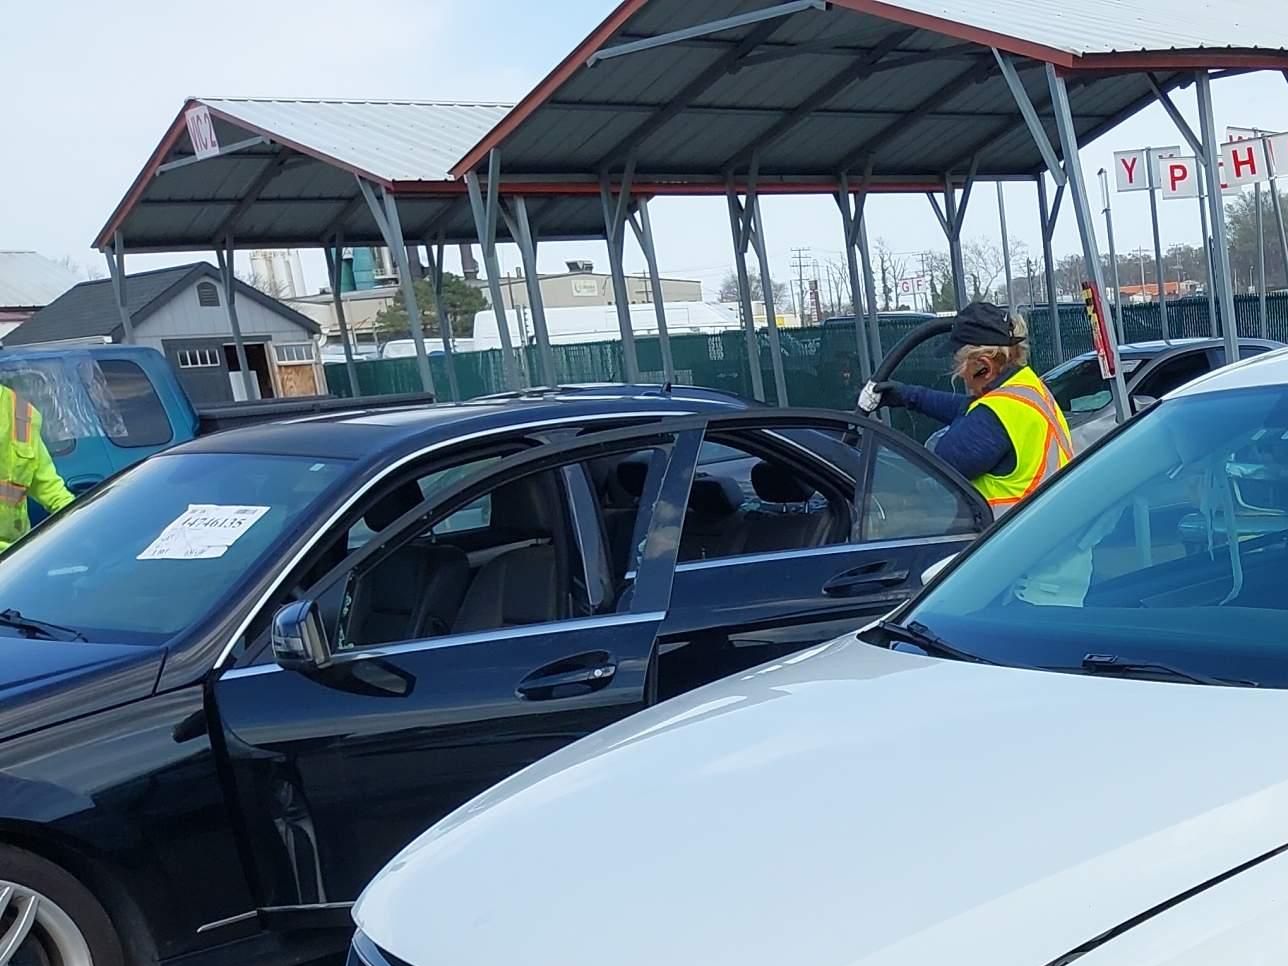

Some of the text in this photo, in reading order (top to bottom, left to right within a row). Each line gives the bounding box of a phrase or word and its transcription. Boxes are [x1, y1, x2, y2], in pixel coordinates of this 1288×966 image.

[1121, 157, 1137, 184] Y
[1231, 146, 1257, 178] H
[1169, 164, 1188, 191] P
[902, 281, 910, 293] G
[916, 280, 923, 291] F
